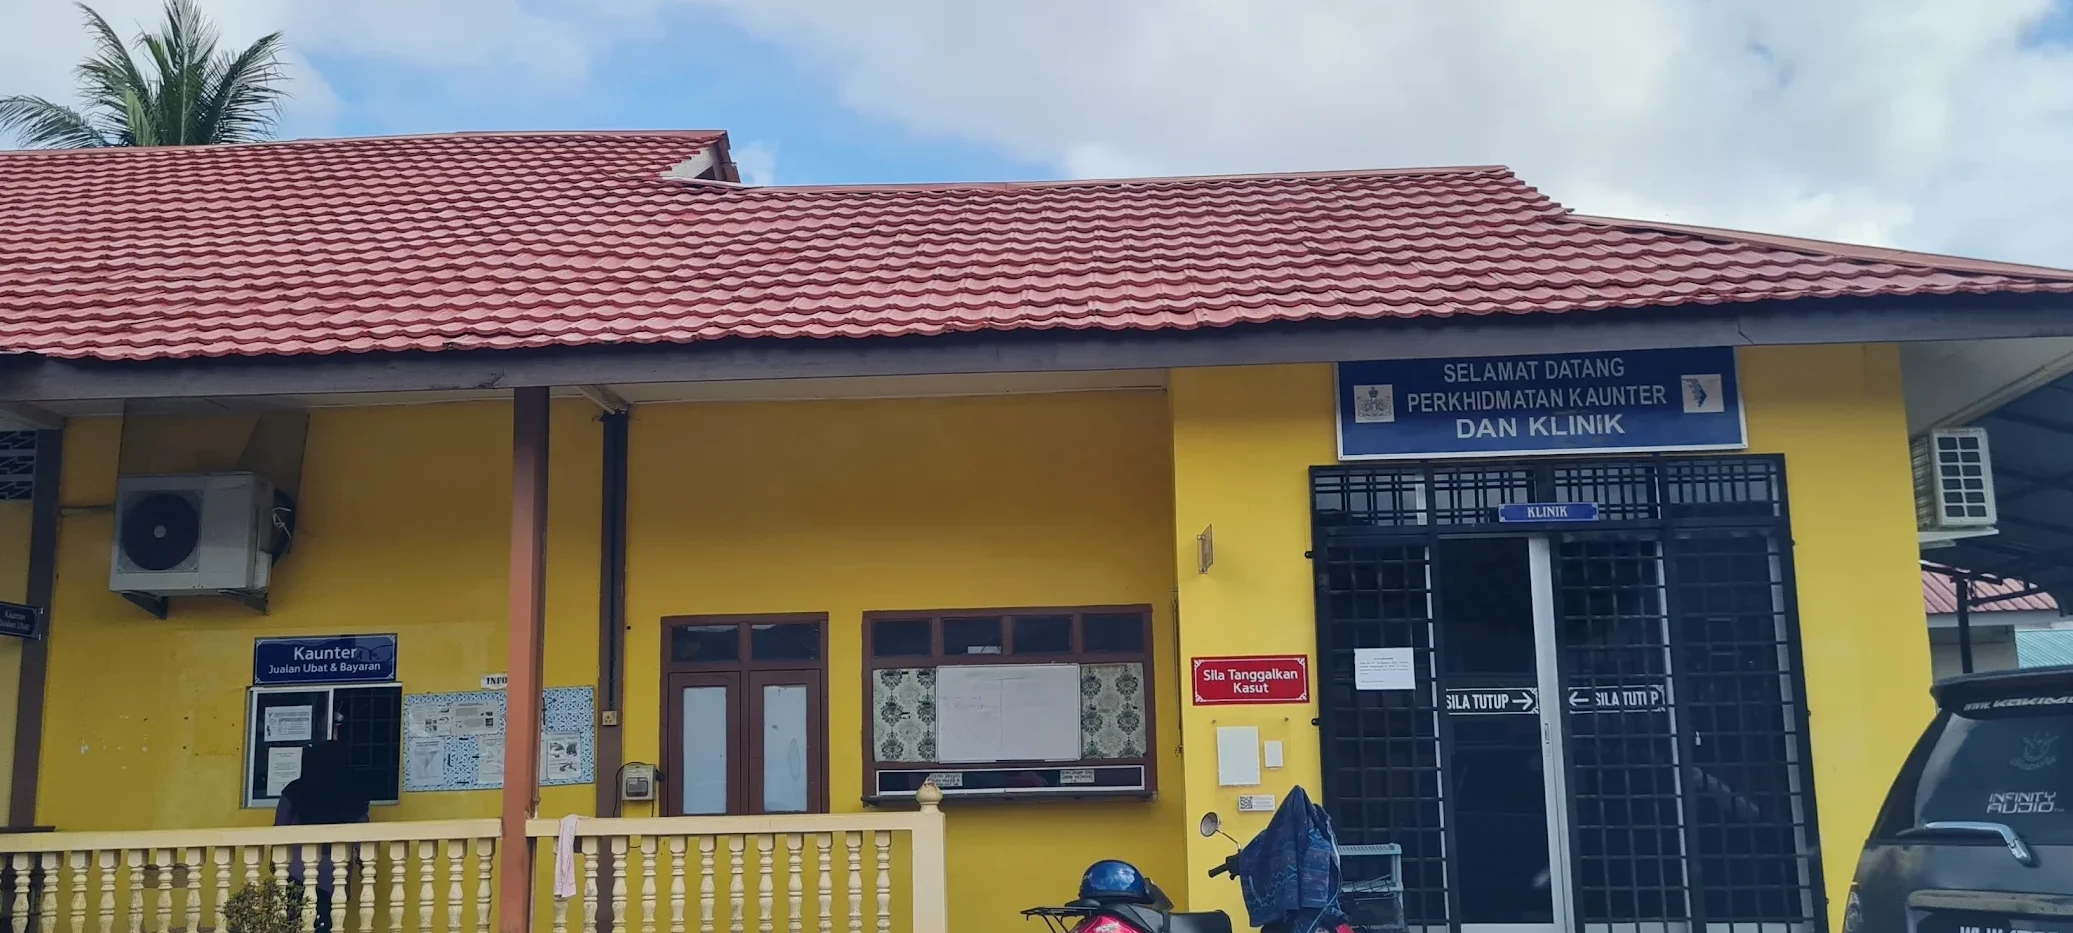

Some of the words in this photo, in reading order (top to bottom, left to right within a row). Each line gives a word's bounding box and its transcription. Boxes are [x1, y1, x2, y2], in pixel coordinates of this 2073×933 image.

[1443, 361, 1539, 383] SELAMAT
[1545, 357, 1625, 380] DATANG
[1407, 388, 1564, 413] PERKHIDMATAN
[1569, 385, 1667, 407] KAUNTER
[1456, 417, 1518, 439] DAN
[1529, 413, 1626, 437] KLINIK
[1526, 505, 1568, 519] KLINIK
[293, 647, 358, 661] Kaunter
[268, 664, 301, 675] Jualan
[302, 662, 328, 673] Ubat
[330, 662, 338, 672] &
[339, 662, 381, 674] Bayaran
[1203, 669, 1226, 682] Sila
[1228, 668, 1299, 683] Tanggalkan
[1233, 683, 1270, 694] Kasut
[1446, 694, 1471, 710] SILA
[1471, 693, 1509, 710] TUTUP
[1595, 691, 1620, 706] SILA
[1988, 791, 2057, 803] INFINITY
[1986, 801, 2055, 814] AUDIO
